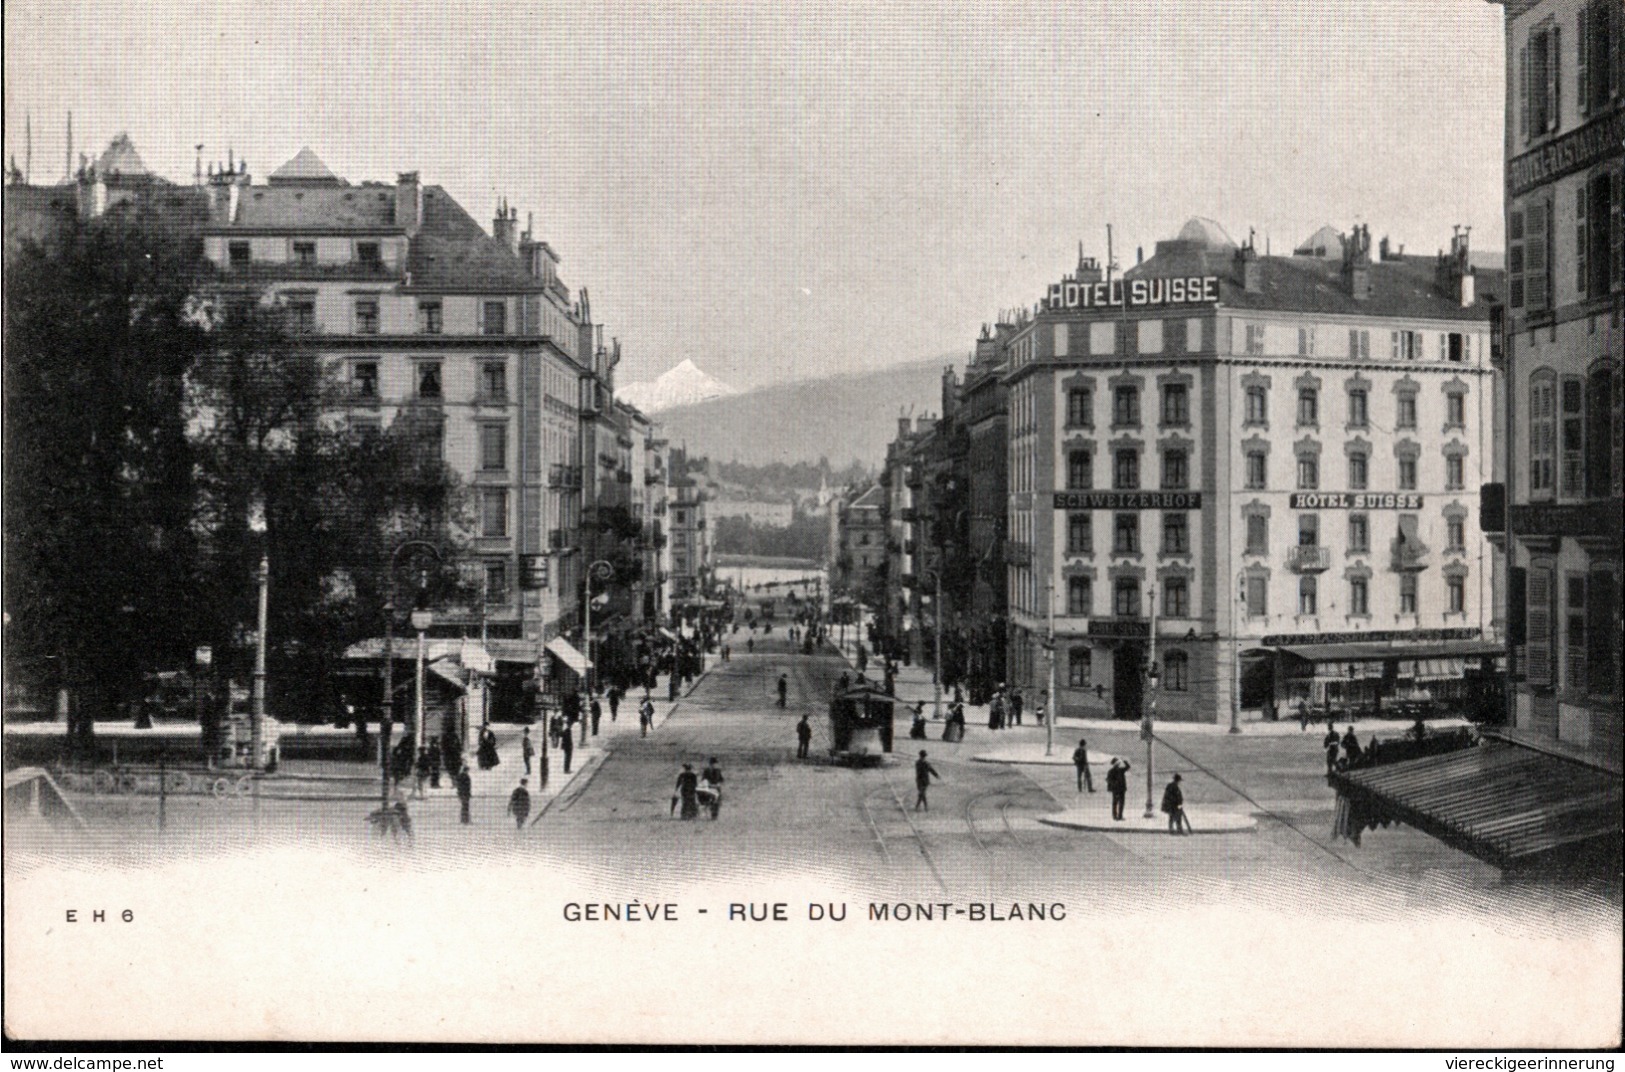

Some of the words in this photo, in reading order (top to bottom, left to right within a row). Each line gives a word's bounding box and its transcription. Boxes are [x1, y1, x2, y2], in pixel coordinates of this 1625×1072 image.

[1131, 276, 1218, 304] SUISSE
[1056, 494, 1198, 507] SCHWEIZERHOF
[1354, 493, 1418, 508] SUISSE
[66, 909, 78, 922] E
[93, 909, 105, 922] H
[121, 909, 134, 922] 6
[563, 899, 679, 921] GENÈVE
[729, 903, 788, 921] RUE
[809, 903, 846, 921] DU
[869, 903, 1067, 921] MONT-BLANC
